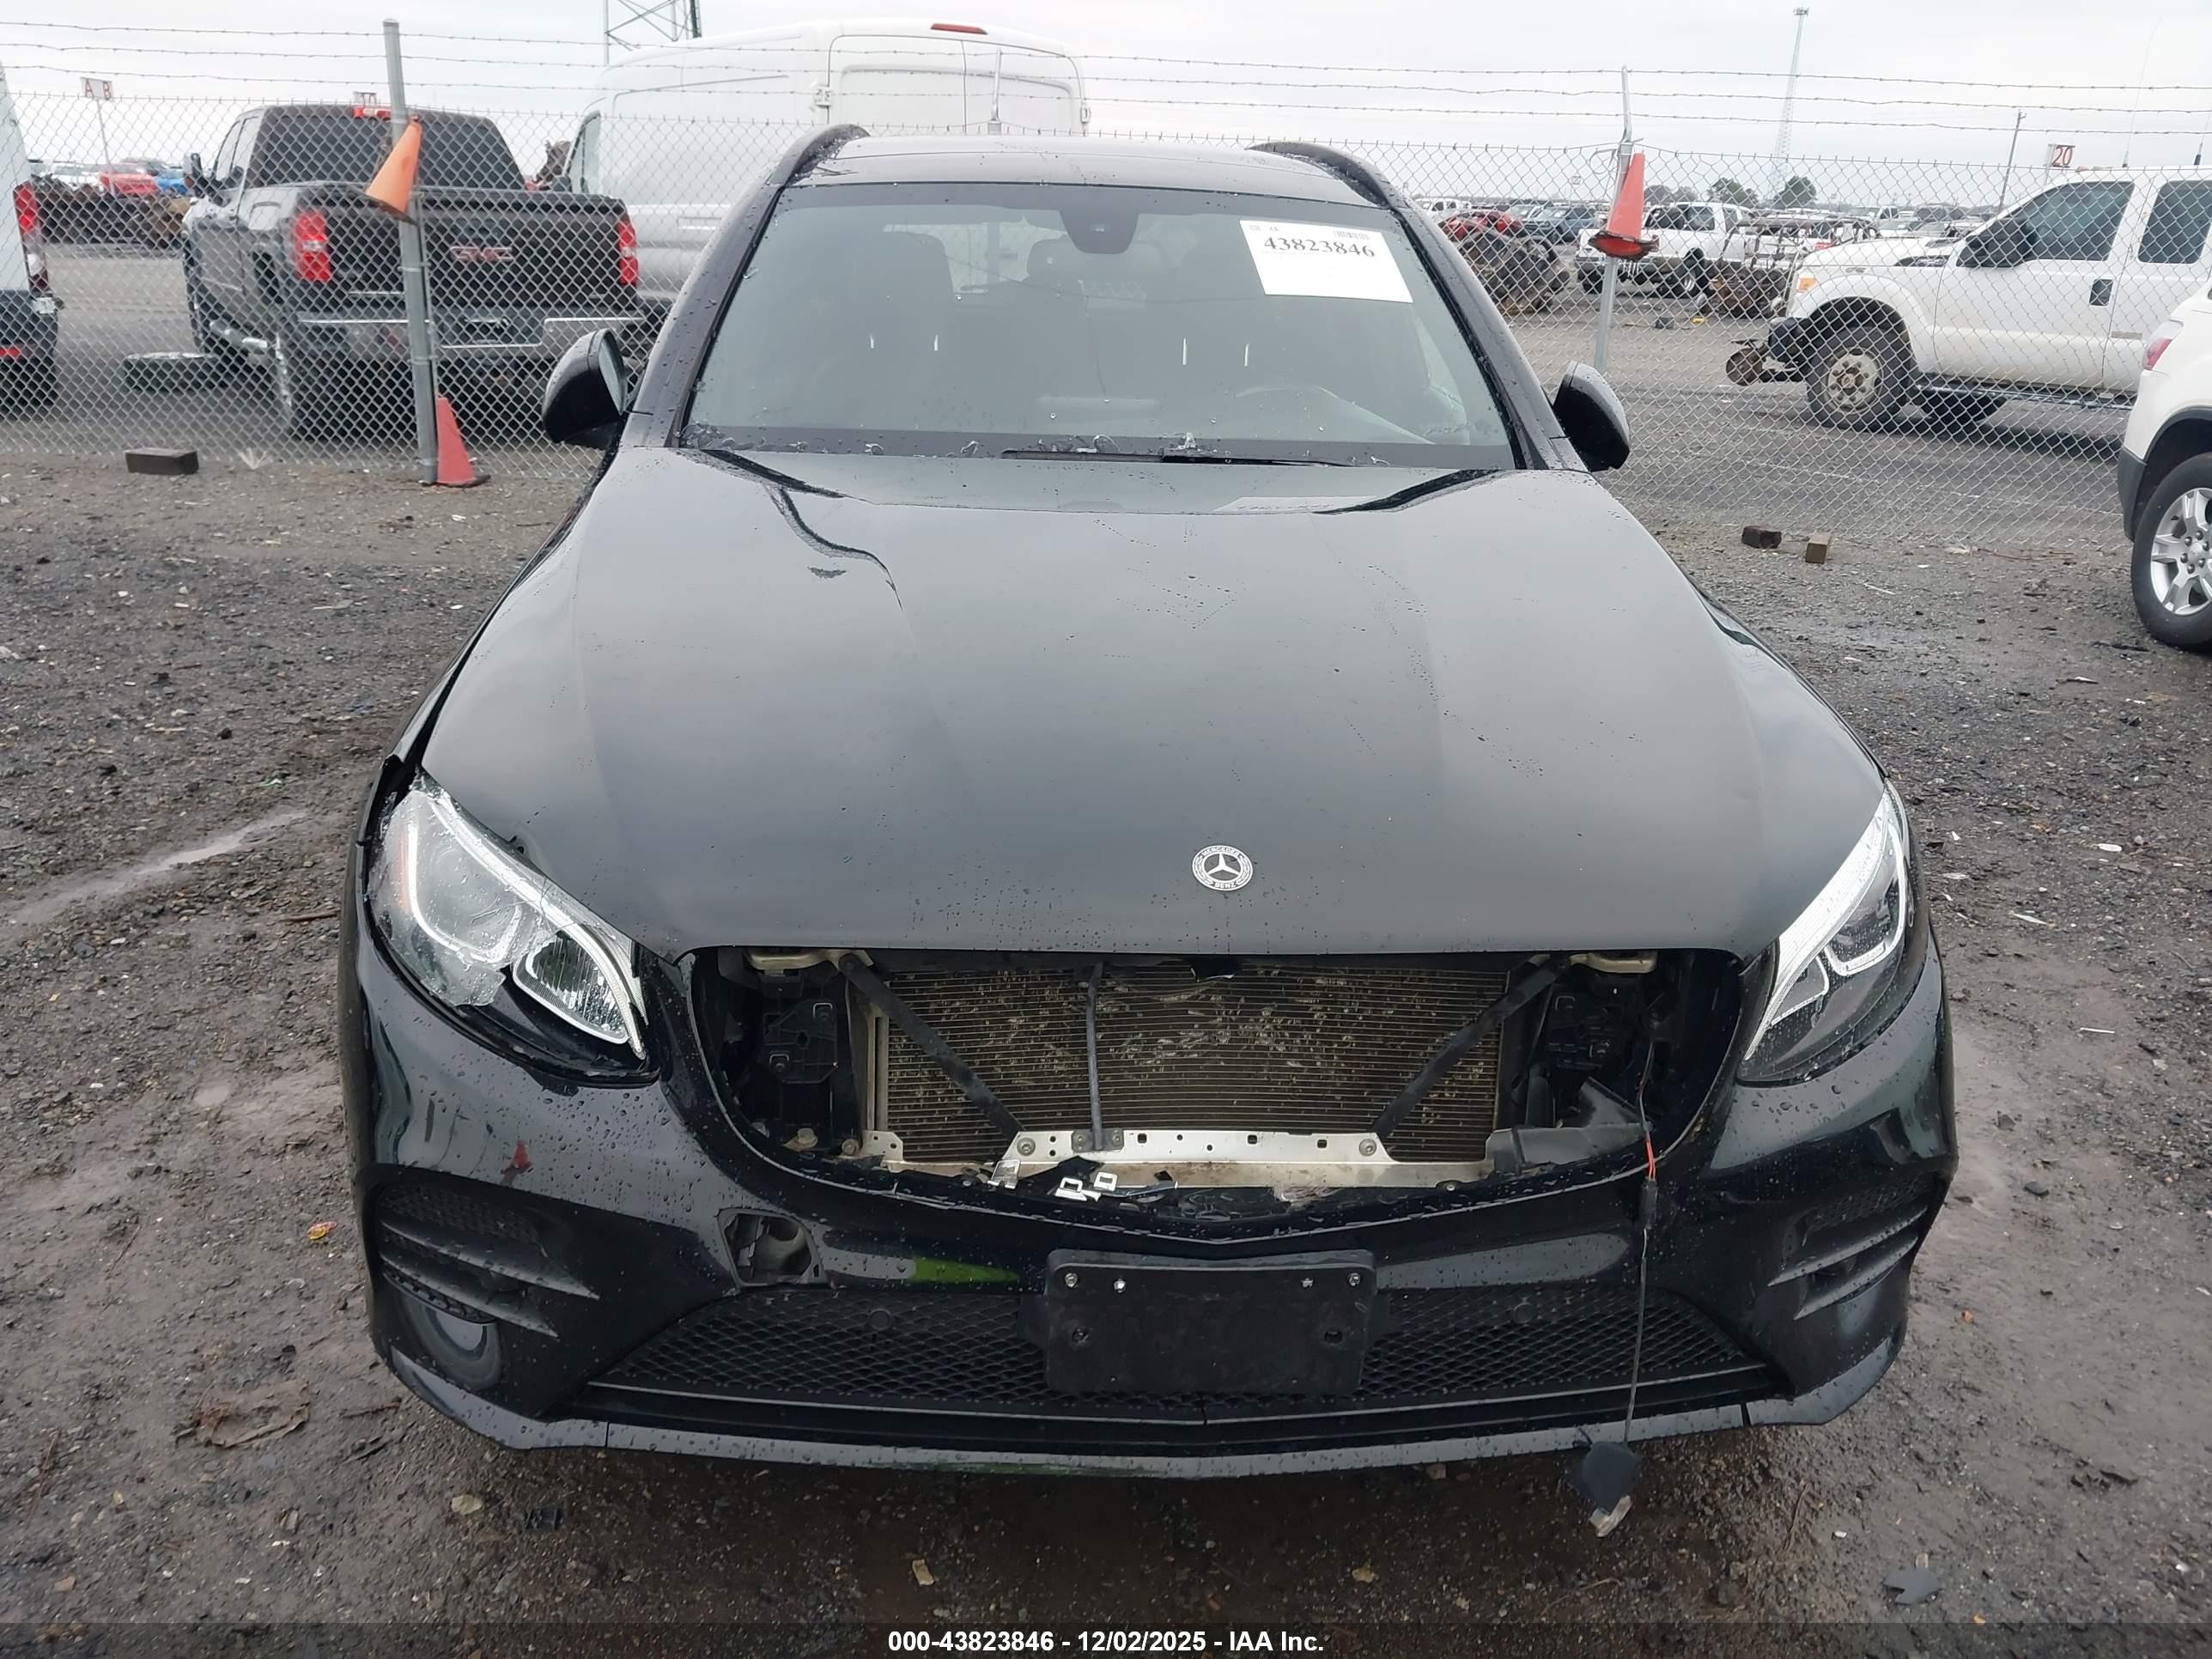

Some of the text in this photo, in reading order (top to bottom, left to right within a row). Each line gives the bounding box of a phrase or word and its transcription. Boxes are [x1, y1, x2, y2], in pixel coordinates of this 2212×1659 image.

[85, 78, 112, 100] A B
[2051, 145, 2073, 167] 20
[450, 246, 514, 262] GMC
[1264, 236, 1375, 258] 43823846
